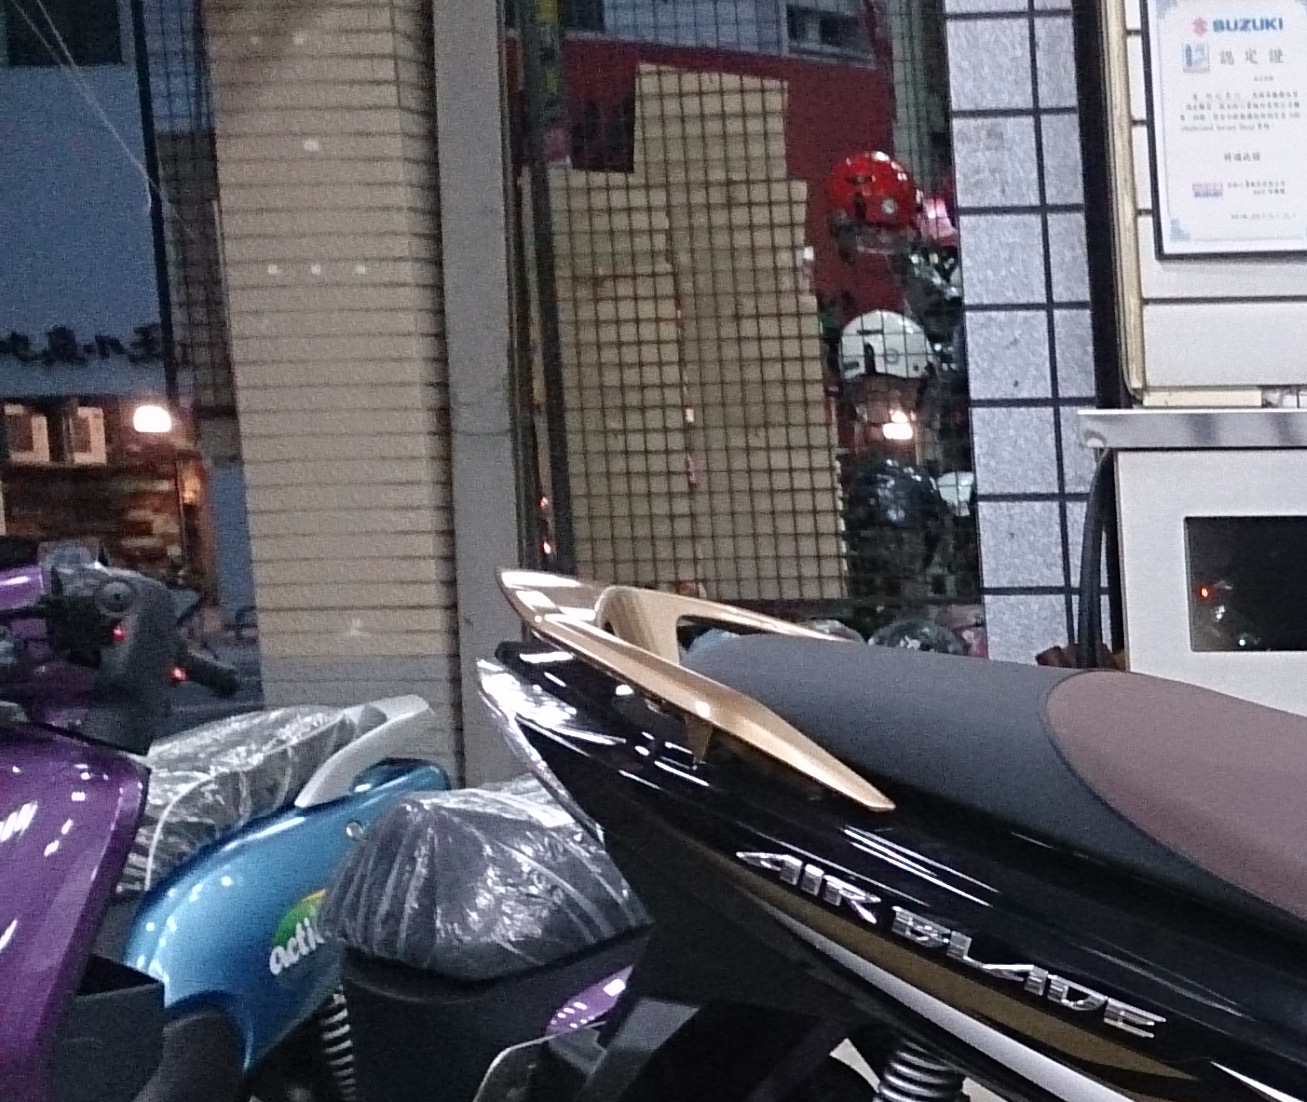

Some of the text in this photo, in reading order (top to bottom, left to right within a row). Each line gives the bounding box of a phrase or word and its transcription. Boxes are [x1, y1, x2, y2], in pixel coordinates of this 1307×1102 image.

[1212, 17, 1284, 33] SUZUKI
[269, 916, 325, 976] acti
[735, 850, 1167, 1040] AIR BLADE
